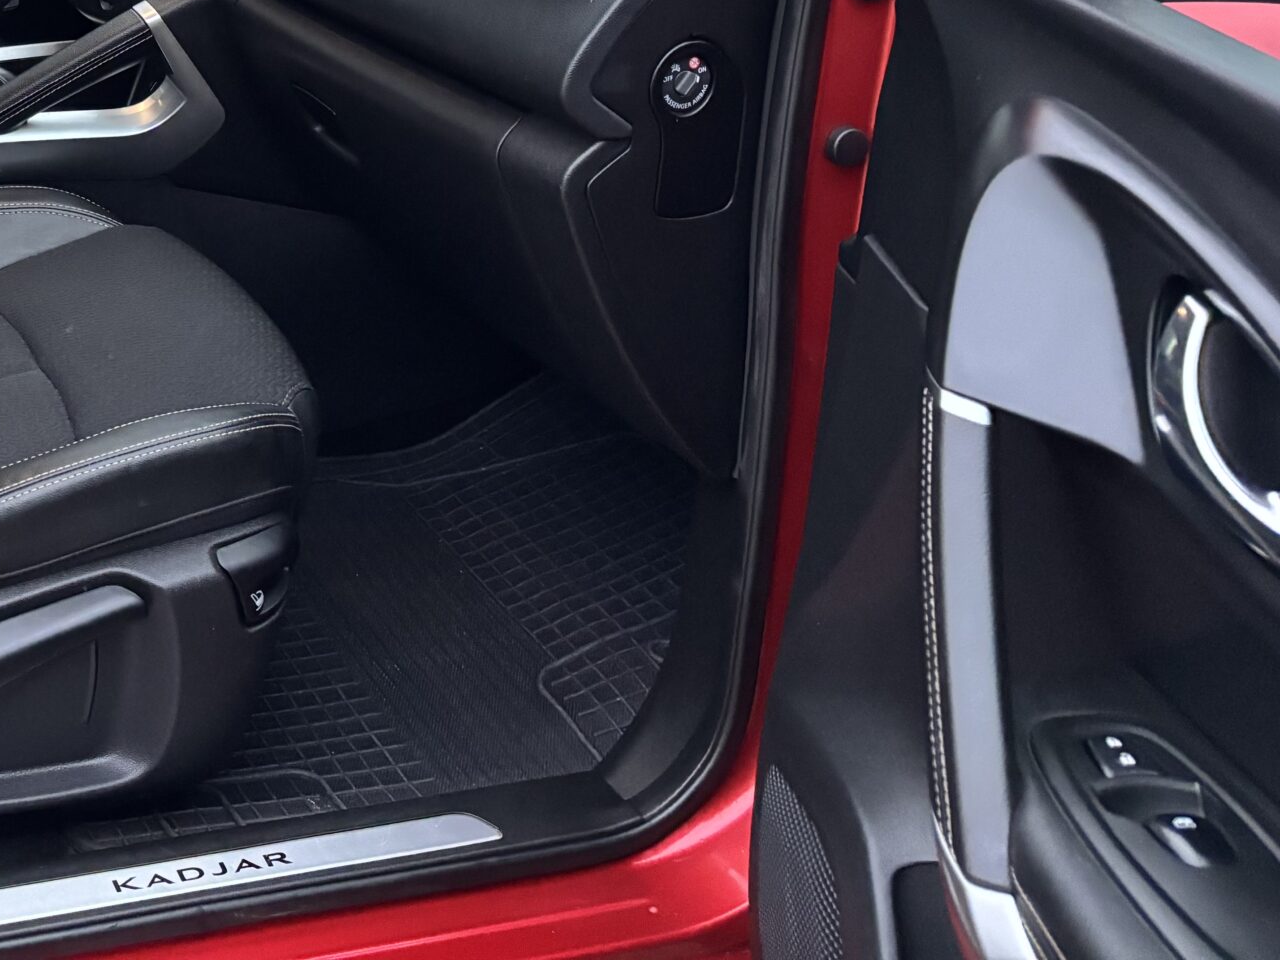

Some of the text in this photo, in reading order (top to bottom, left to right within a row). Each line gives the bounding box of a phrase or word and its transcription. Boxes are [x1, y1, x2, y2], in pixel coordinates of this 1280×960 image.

[663, 84, 709, 110] PASSENGER AIRBAG
[111, 851, 294, 893] KADJAR
